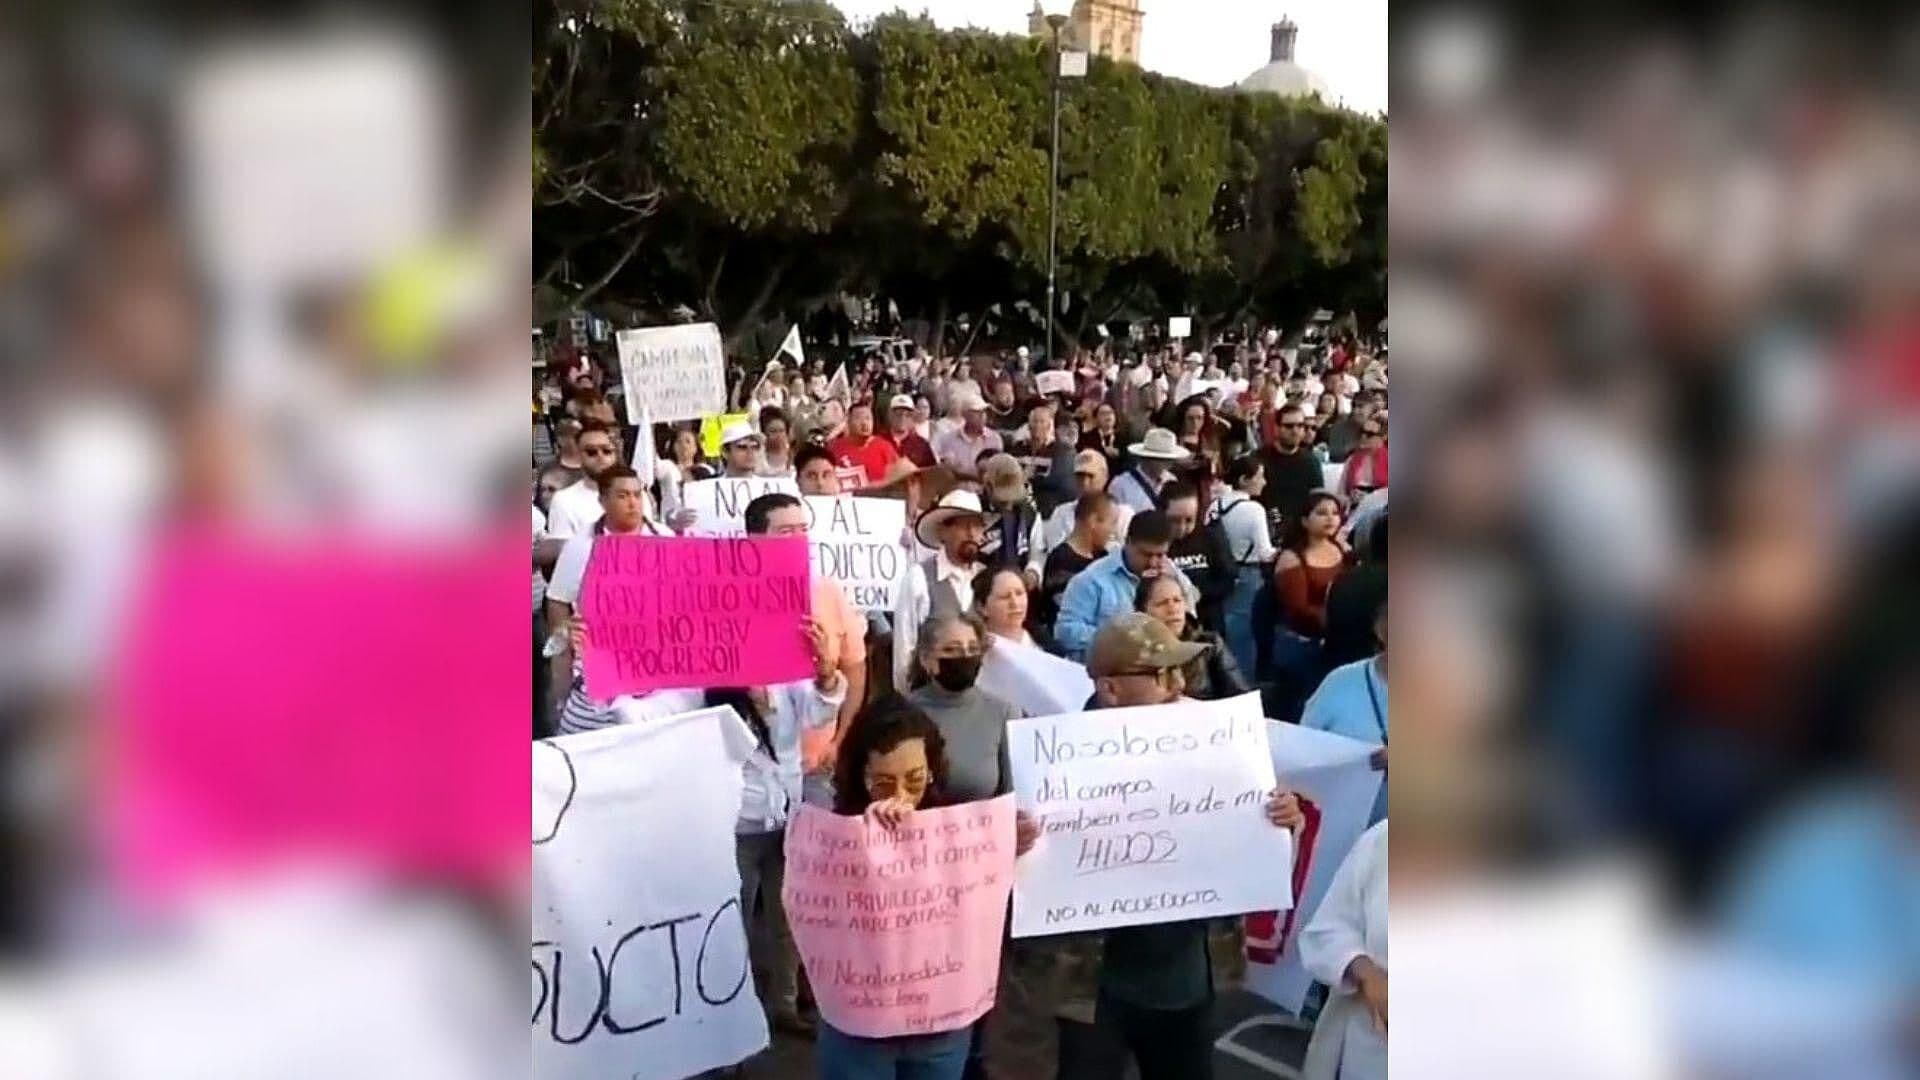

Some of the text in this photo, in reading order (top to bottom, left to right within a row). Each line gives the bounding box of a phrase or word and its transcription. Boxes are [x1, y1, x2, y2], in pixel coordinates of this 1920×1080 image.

[831, 499, 871, 535] AL
[713, 537, 763, 577] NO
[765, 575, 808, 614] SIN
[656, 615, 695, 647] NO
[1077, 830, 1178, 868] HIJOS
[1045, 904, 1078, 924] NO
